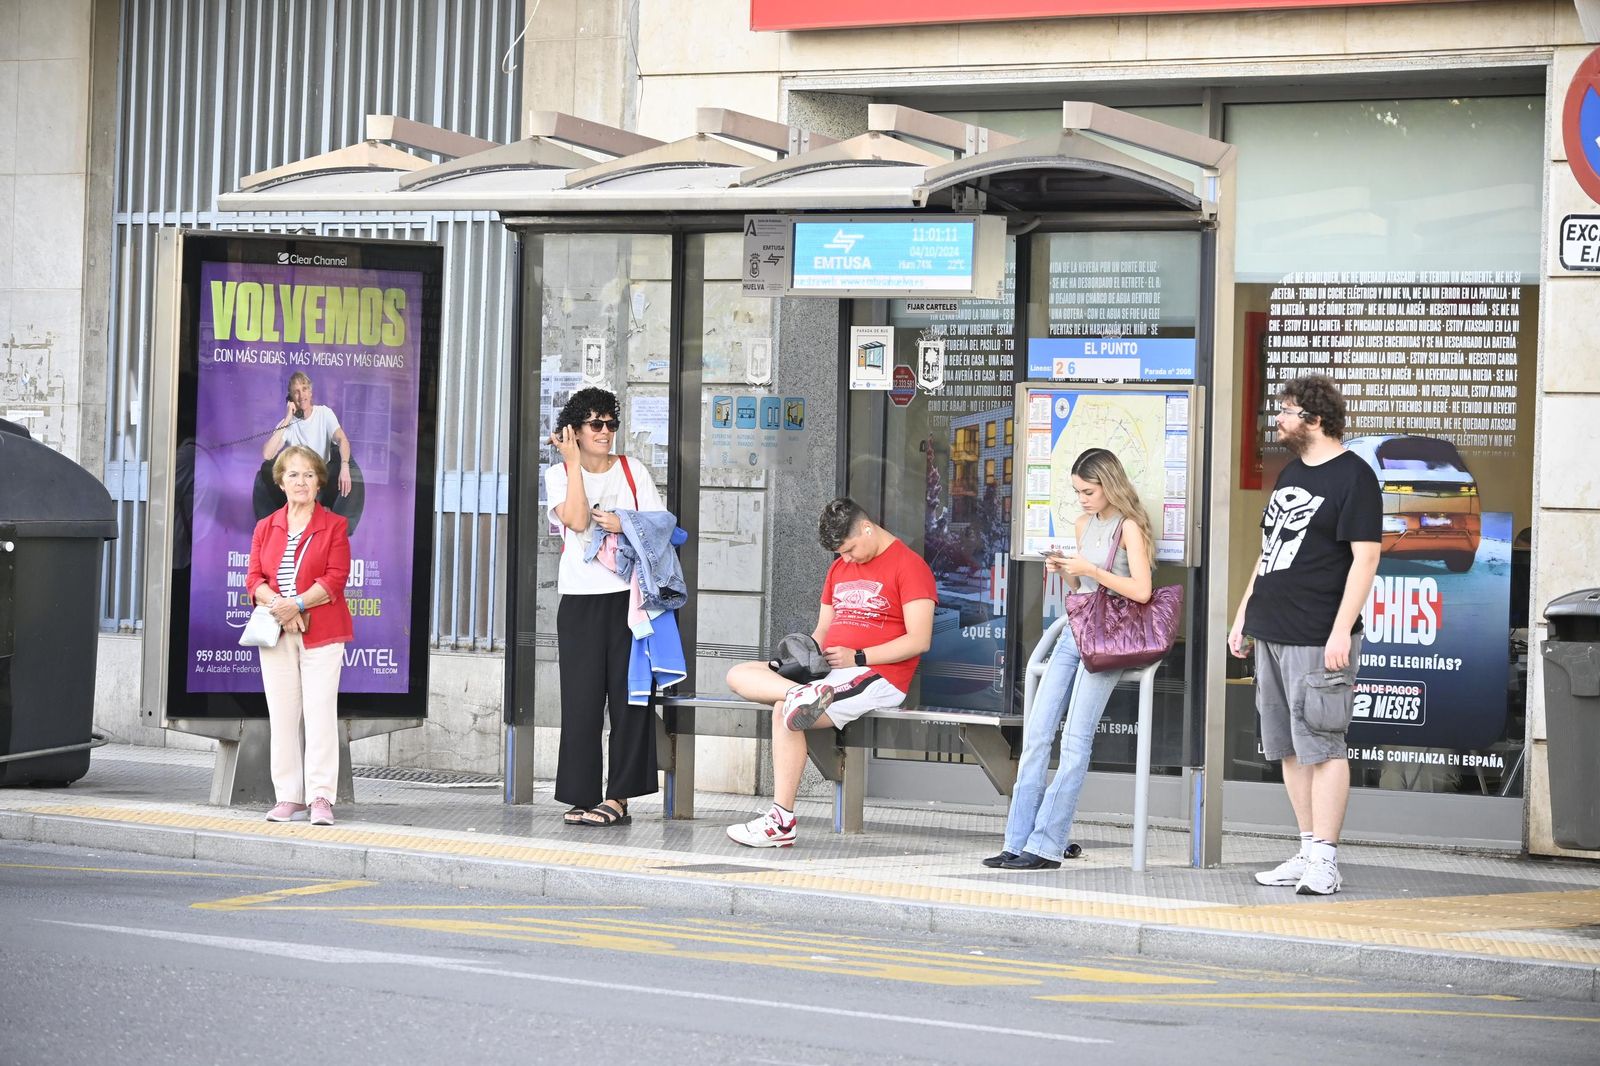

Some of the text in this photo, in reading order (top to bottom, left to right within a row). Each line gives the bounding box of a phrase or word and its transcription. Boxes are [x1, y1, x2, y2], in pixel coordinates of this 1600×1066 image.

[912, 228, 958, 242] 11:01:11
[1566, 224, 1600, 242] EXC
[910, 246, 960, 258] 04/10/2024
[290, 254, 348, 266] Clear Channel
[814, 256, 872, 270] EMTUSA
[1299, 285, 1508, 299] TENGO COCHE ELÉCTRICO ERROR PANTALLA
[210, 280, 405, 346] VOLVEMOS
[1282, 301, 1457, 315] BATERÍA DÓNDE ESTOY ARCÉN NECESITO
[1284, 320, 1494, 332] ESTOY CUNETA PINCHADO CUATRO RUEDAS ESTOY ATASCADO
[1282, 334, 1516, 348] ARRANCA DEJADO LUCES ENCENDIDAS DESCARGADO BATERÍA
[1084, 342, 1138, 355] EL PUNTO
[214, 347, 404, 368] CON MÁS GIGAS, MÁS MEGAS Y MÁS GANAS
[1290, 350, 1496, 364] DEJAR TIRADO CAMBIAR RUEDA ESTOY BATERÍA NECESITO
[1056, 362, 1064, 374] 2
[1068, 362, 1075, 374] 6
[1145, 367, 1166, 375] Parada
[1280, 366, 1492, 381] ESTOY CARRETERA ARCÉN REVENTADO RUEDA
[1342, 385, 1489, 399] MOTOR HUELE QUEMADO PUEDO SALIR, ESTOY
[1360, 401, 1482, 413] AUTOPISTA TENEMOS TENIDO
[1356, 417, 1489, 432] NECESITO REMOLQUEN, QUEDADO
[227, 592, 238, 607] TV
[226, 610, 250, 620] prime
[962, 624, 991, 640] ¿QUÉ
[196, 650, 252, 661] 959 830 000
[1390, 654, 1462, 671] ELEGIRÍAS?
[194, 664, 260, 673] Av. Alcalde Federico
[1371, 685, 1384, 694] DE
[1386, 686, 1419, 696] PAGOS
[1373, 696, 1420, 721] MESES
[1348, 747, 1504, 768] DE MÁS CONFIANZA EN ESPAÑA
